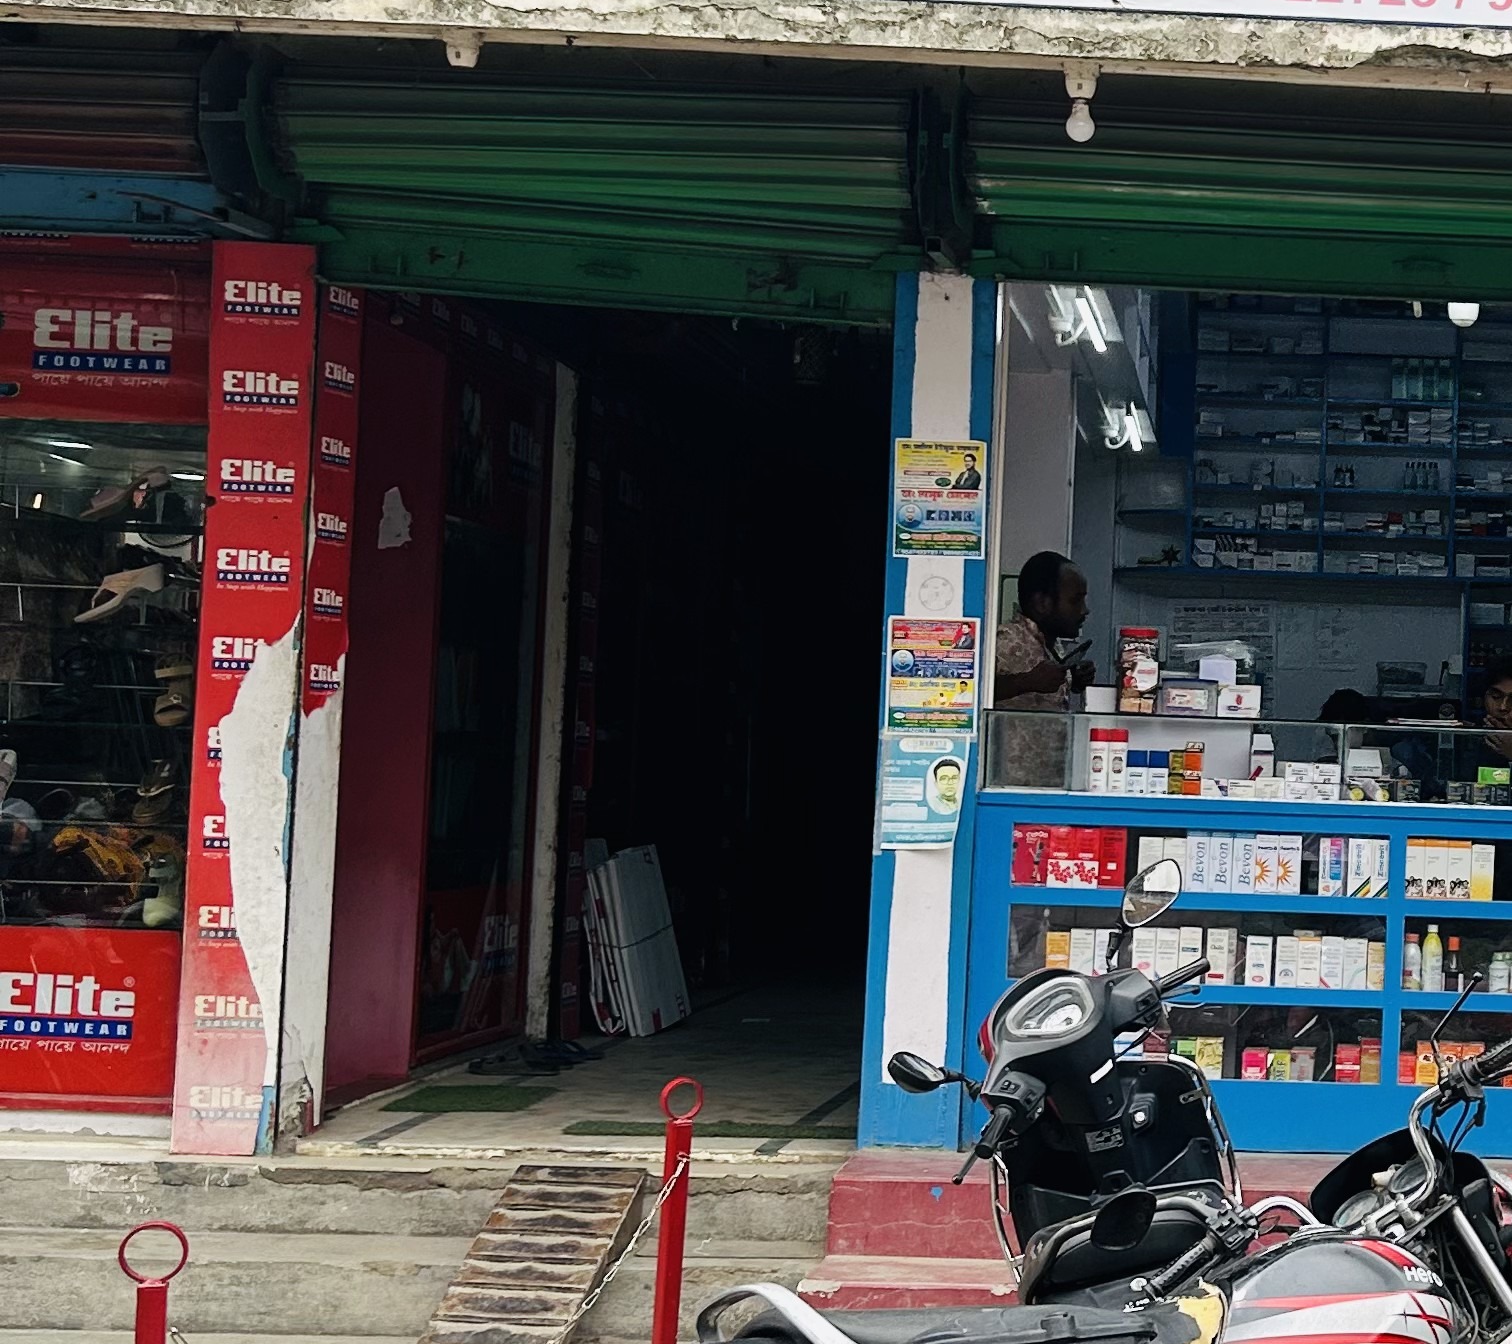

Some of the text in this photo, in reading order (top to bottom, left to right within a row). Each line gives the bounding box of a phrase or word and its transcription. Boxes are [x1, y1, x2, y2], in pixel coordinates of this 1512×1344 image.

[224, 280, 301, 305] Elite
[329, 286, 359, 310] Elite
[227, 304, 298, 315] FOOTWEAR
[34, 309, 172, 352] Elite
[38, 355, 166, 370] FOOTWEAR
[325, 361, 355, 384] Elite
[223, 371, 299, 395] Elite
[226, 394, 296, 405] FOOTWEAR
[321, 437, 351, 458] Elite
[220, 459, 295, 482] Elite
[223, 482, 293, 493] FOOTWEAR
[318, 513, 348, 533] Elite
[217, 548, 290, 573] Elite
[219, 572, 288, 582] FOOTWEAR
[313, 588, 343, 608] Elite
[212, 637, 265, 659] Elit
[215, 660, 253, 670] FOOT
[310, 664, 340, 683] Elite
[1192, 840, 1206, 884] Bevon
[1215, 842, 1228, 885] Bevon
[1238, 843, 1252, 886] Bevon
[199, 906, 237, 928] Eli
[201, 930, 238, 940] FOOT
[0, 971, 135, 1017] Elite
[195, 995, 263, 1017] Elite
[0, 1019, 127, 1035] FOOTWEAR
[36, 1039, 76, 1053] পায়ে
[80, 1040, 131, 1054] আনন্দ
[190, 1086, 263, 1110] Elite
[1403, 1266, 1443, 1287] Hero
